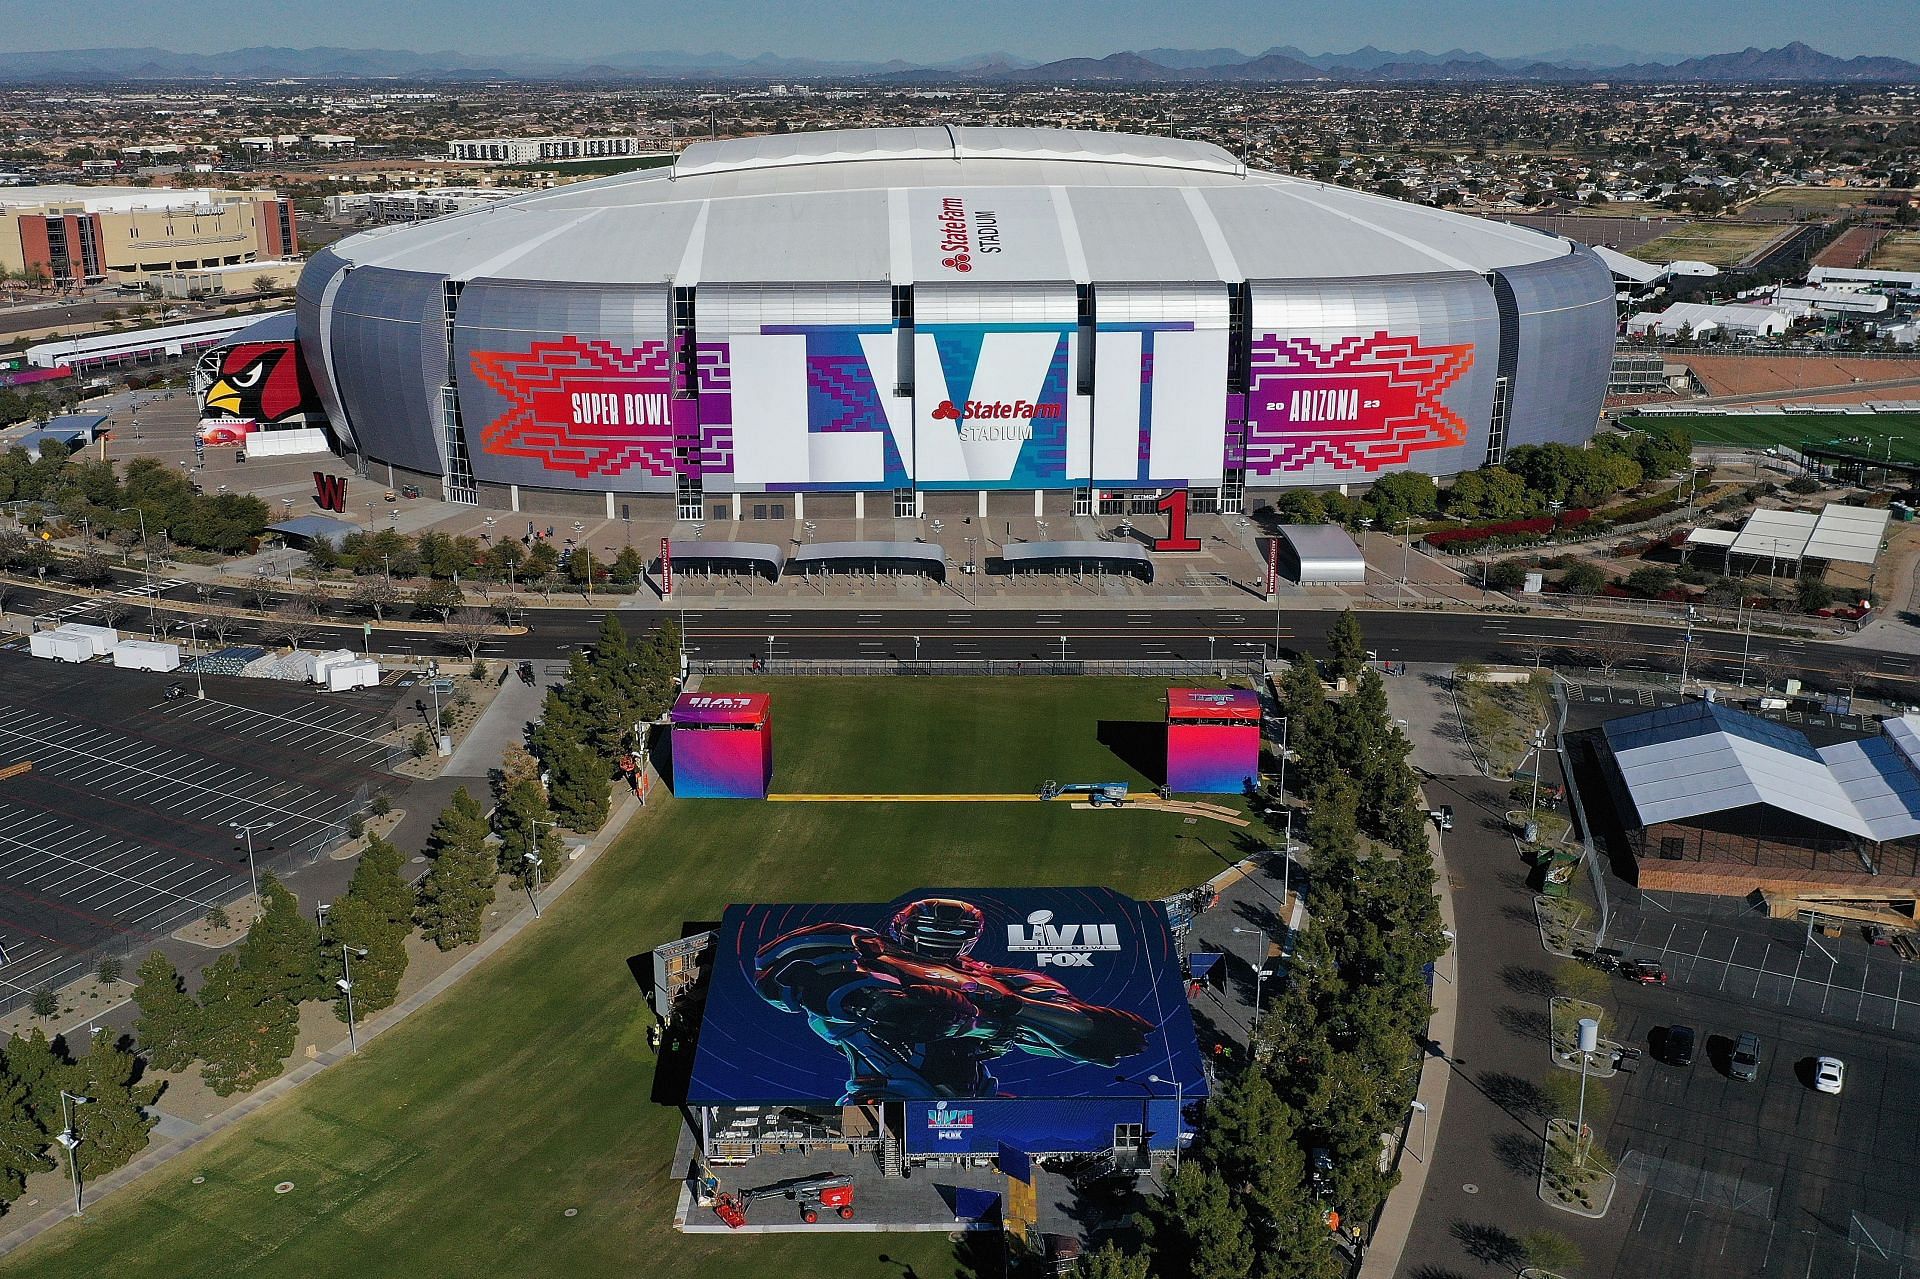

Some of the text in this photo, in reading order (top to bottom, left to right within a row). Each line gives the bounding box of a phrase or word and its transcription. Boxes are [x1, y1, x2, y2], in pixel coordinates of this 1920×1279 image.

[975, 211, 1001, 253] STADIUM
[571, 393, 671, 425] SUPER BOWL
[1266, 389, 1380, 421] 20 ARIZONA 23
[960, 426, 1033, 441] STADIUM
[312, 471, 348, 513] W
[1153, 489, 1202, 552] 1
[1037, 953, 1095, 967] FOX
[939, 1130, 963, 1140] FOX
